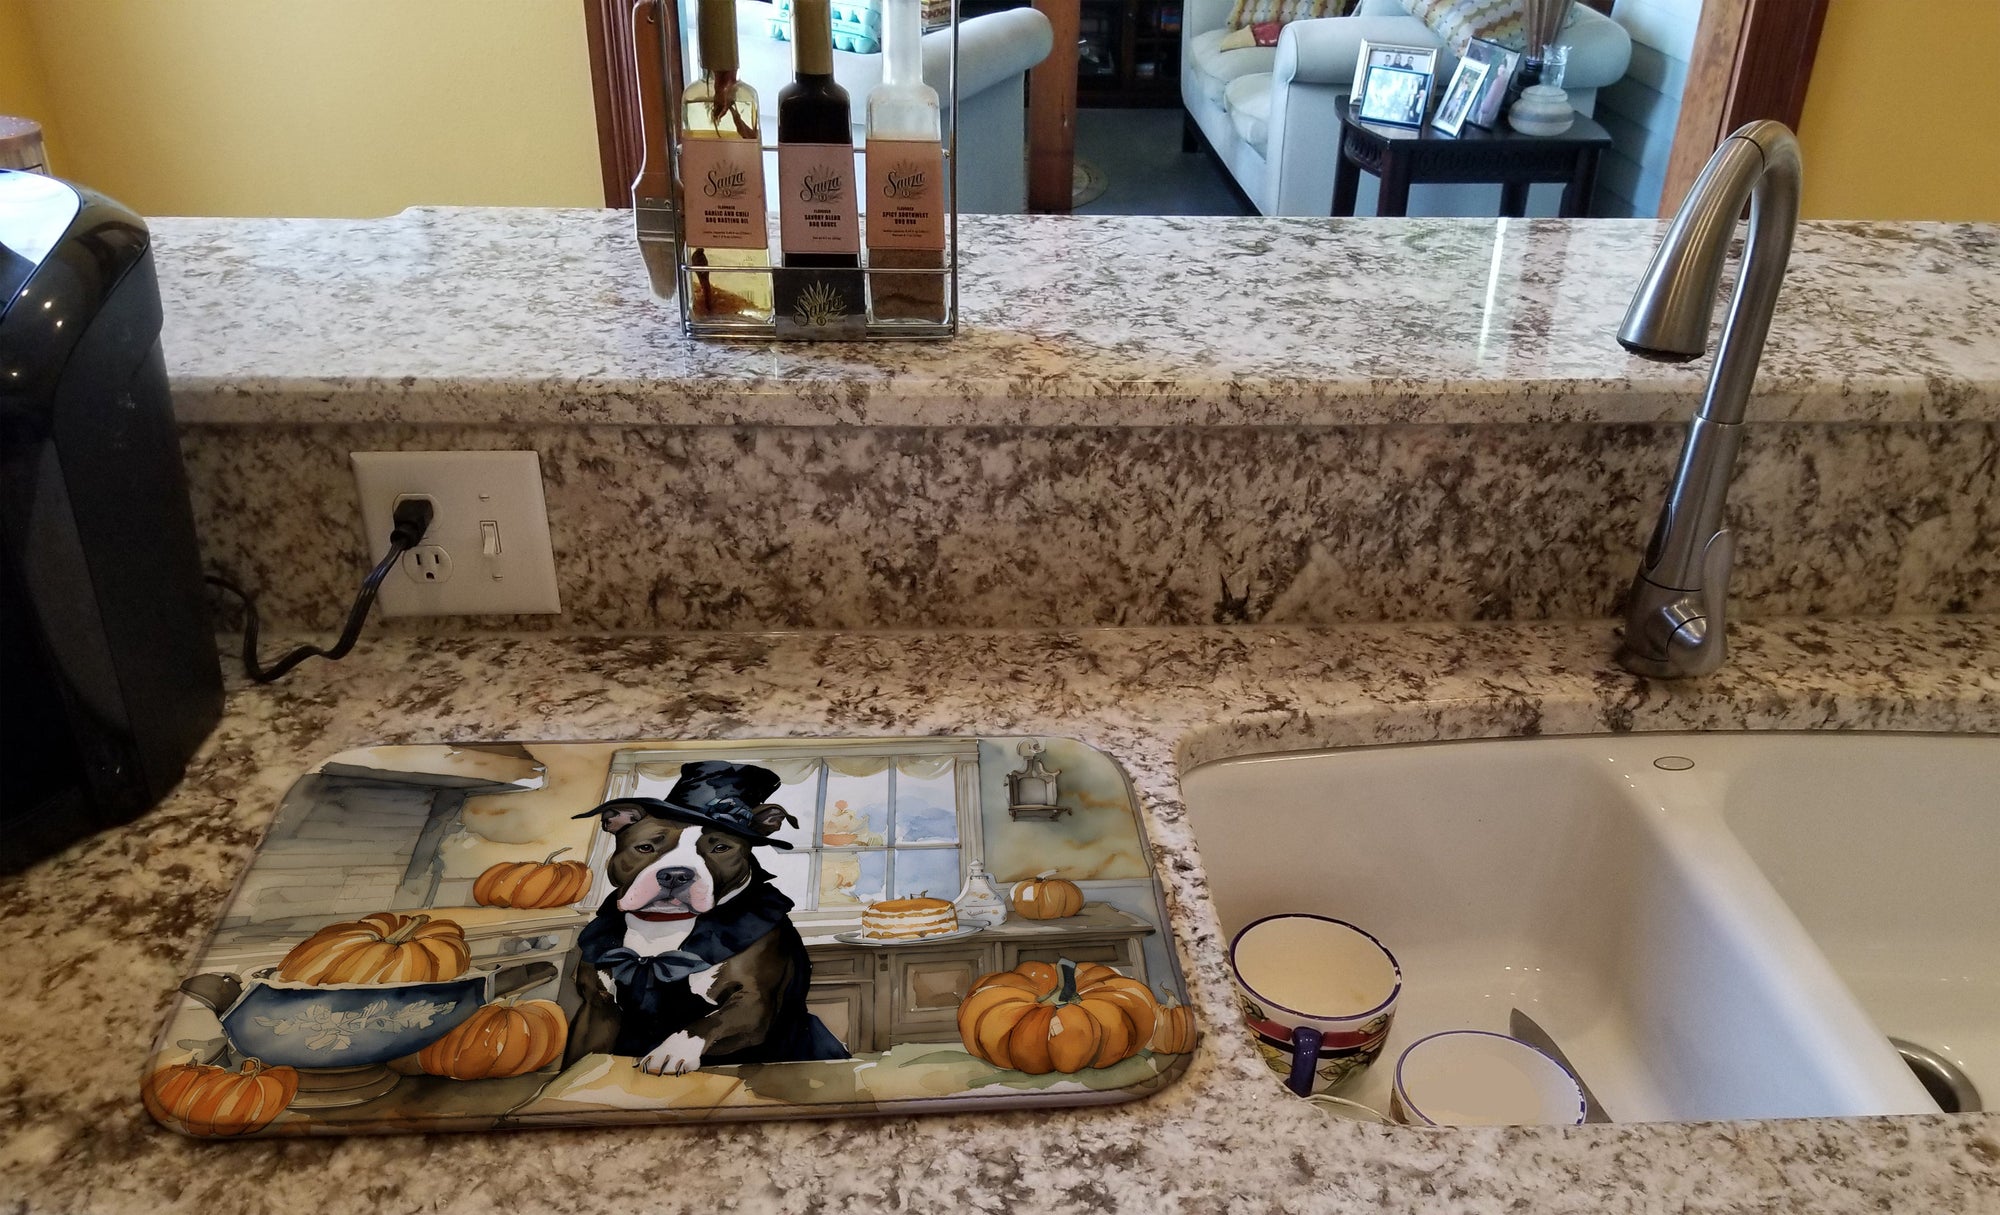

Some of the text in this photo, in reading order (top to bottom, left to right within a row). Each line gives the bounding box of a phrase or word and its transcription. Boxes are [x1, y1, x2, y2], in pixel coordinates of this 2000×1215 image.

[704, 170, 746, 197] Sauza
[800, 175, 841, 202] Sauza
[884, 171, 924, 198] Sauza
